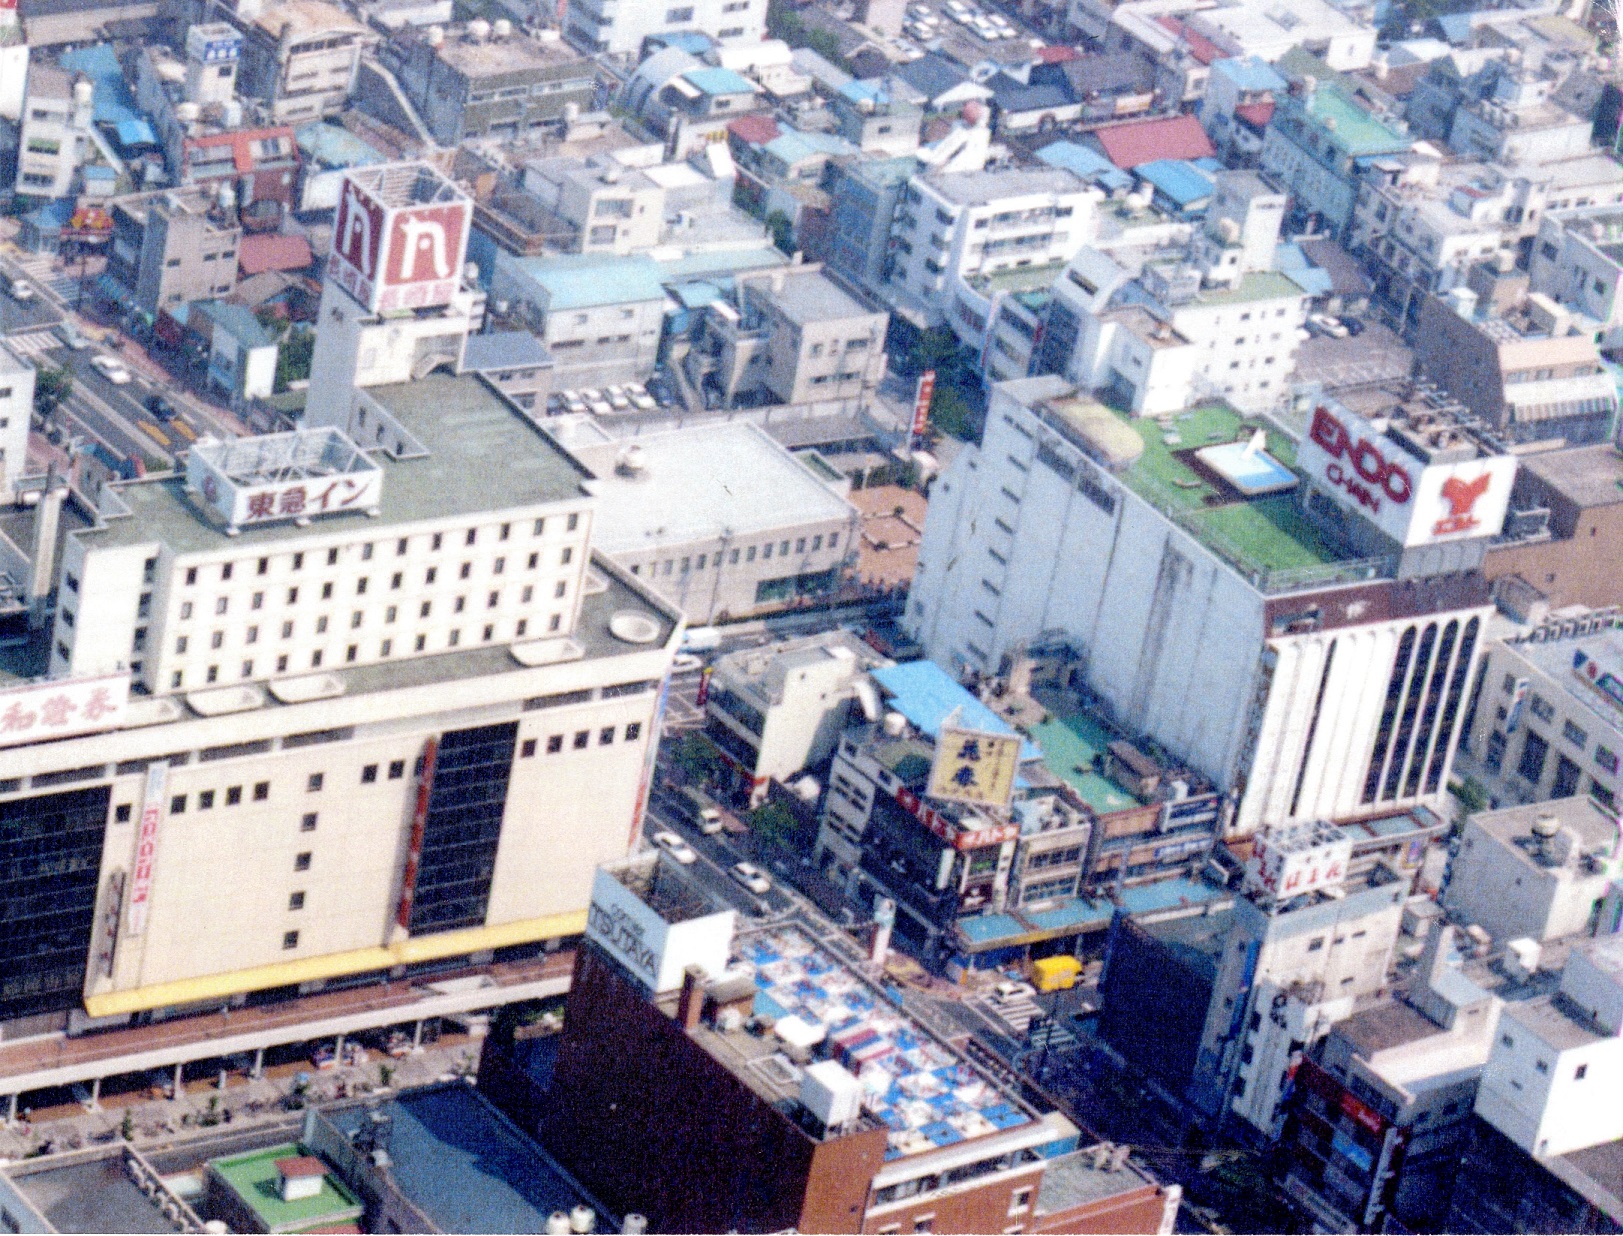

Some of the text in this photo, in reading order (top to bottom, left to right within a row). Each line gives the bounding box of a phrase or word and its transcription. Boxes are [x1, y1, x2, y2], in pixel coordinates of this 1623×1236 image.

[1309, 405, 1413, 504] ENDO
[246, 477, 373, 520] 東急イン
[588, 901, 657, 979] TSUTAYA
